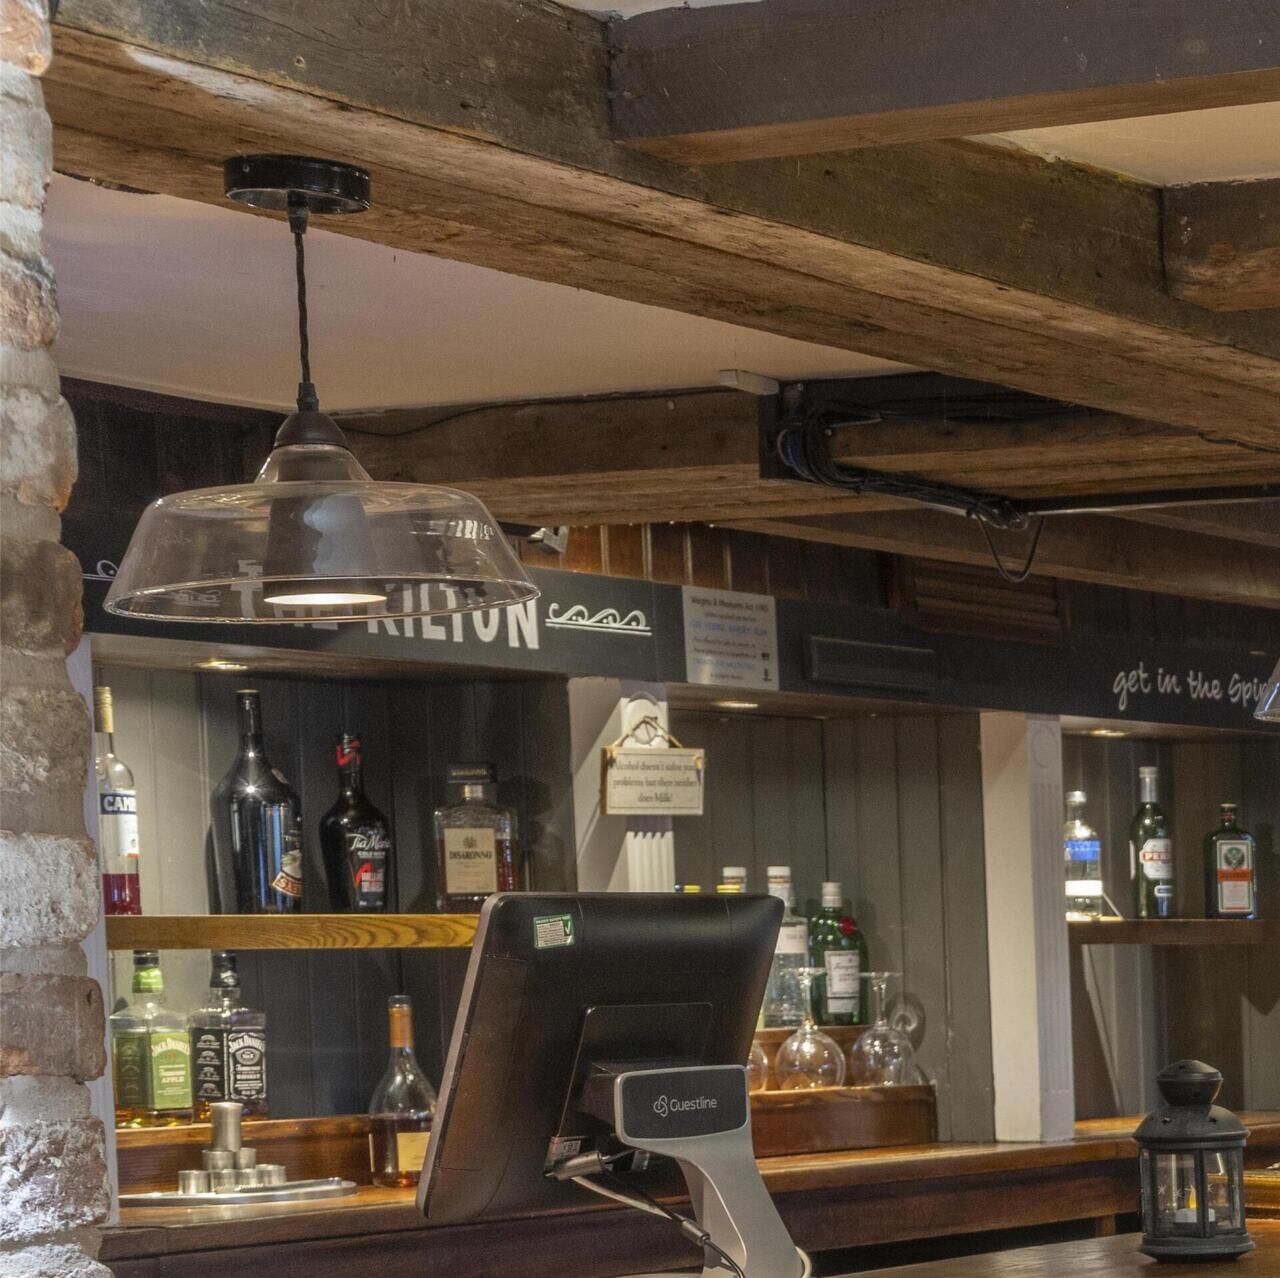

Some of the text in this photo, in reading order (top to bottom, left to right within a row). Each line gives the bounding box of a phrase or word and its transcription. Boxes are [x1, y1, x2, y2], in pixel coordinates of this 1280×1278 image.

[367, 581, 540, 650] KILTON
[1112, 661, 1270, 711] get in the Spir
[669, 1096, 718, 1112] Guestline
